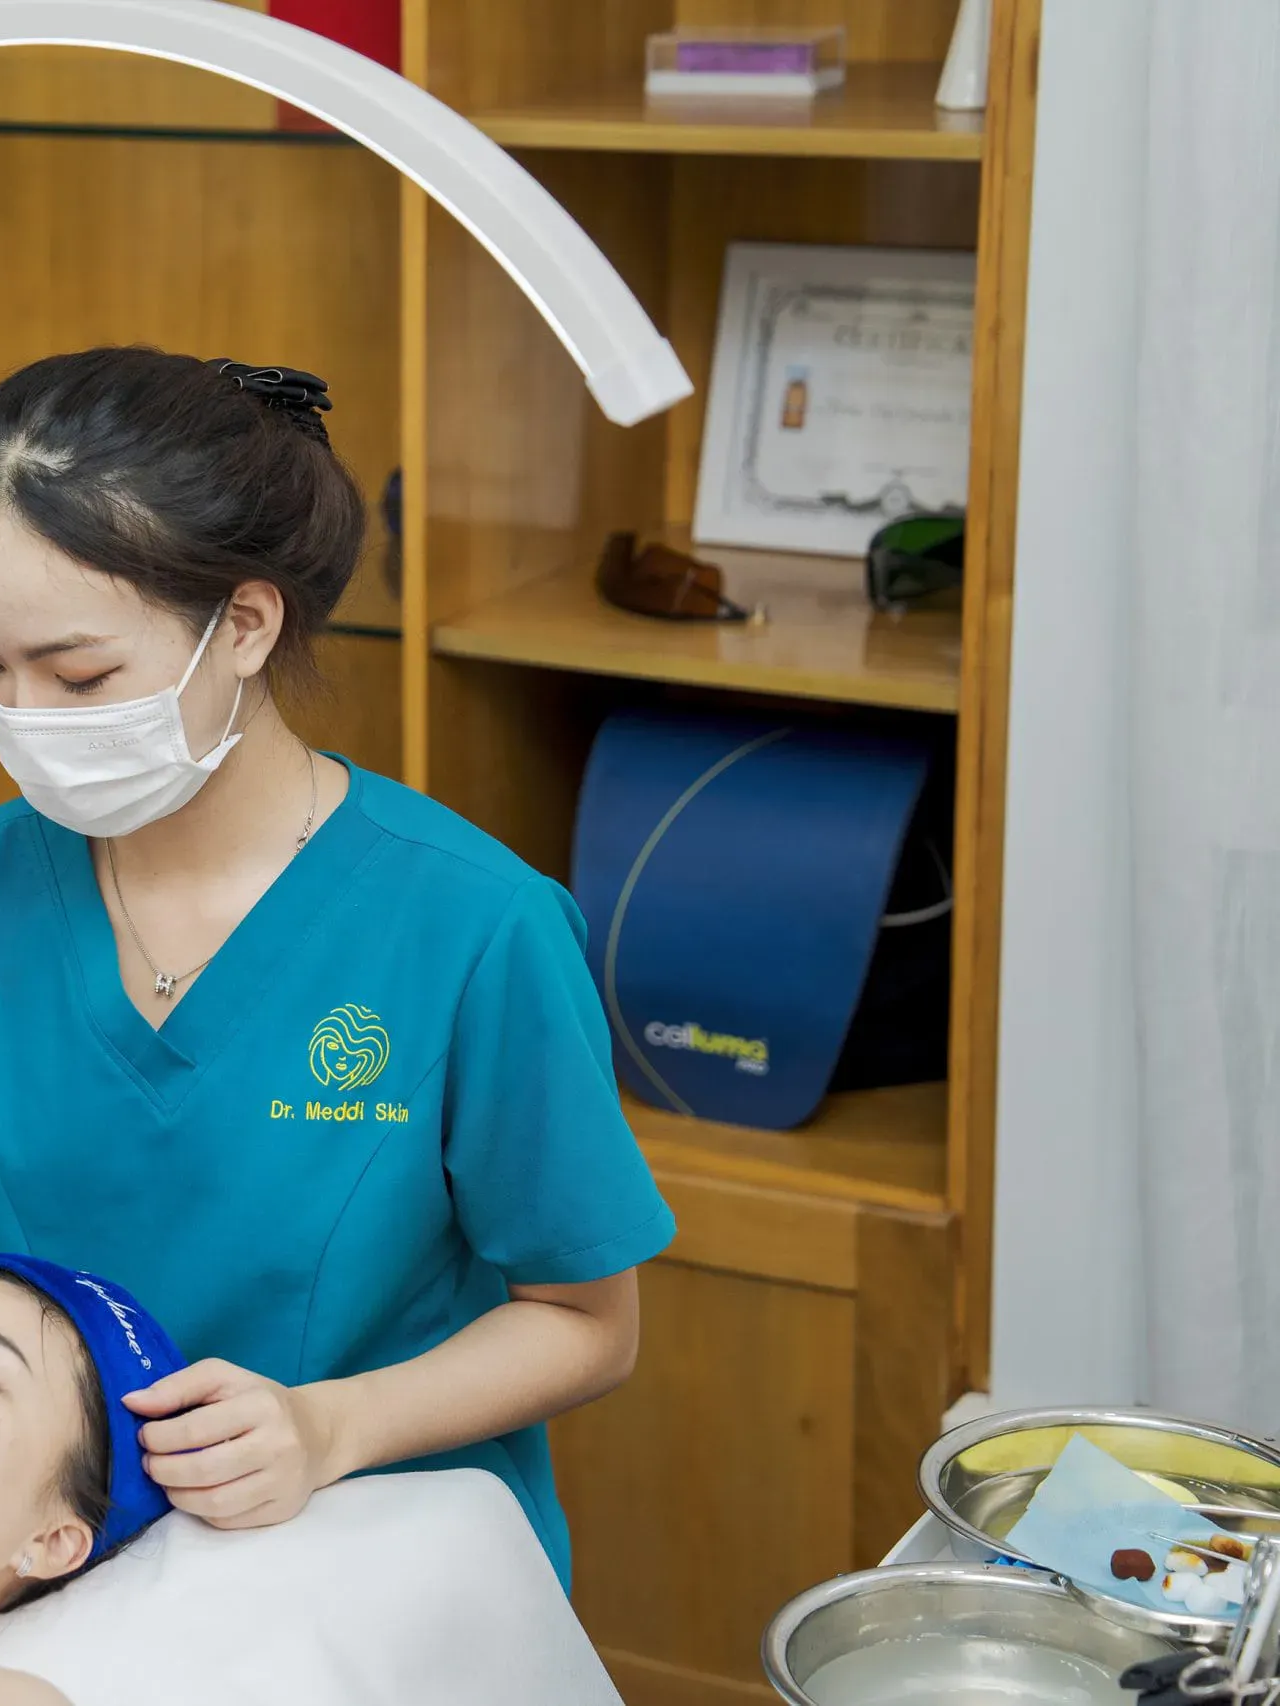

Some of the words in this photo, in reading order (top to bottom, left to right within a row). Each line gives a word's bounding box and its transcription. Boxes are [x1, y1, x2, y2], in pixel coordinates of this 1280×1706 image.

[270, 1100, 294, 1119] Dr.
[305, 1101, 364, 1121] Meddi
[375, 1103, 409, 1122] Skin
